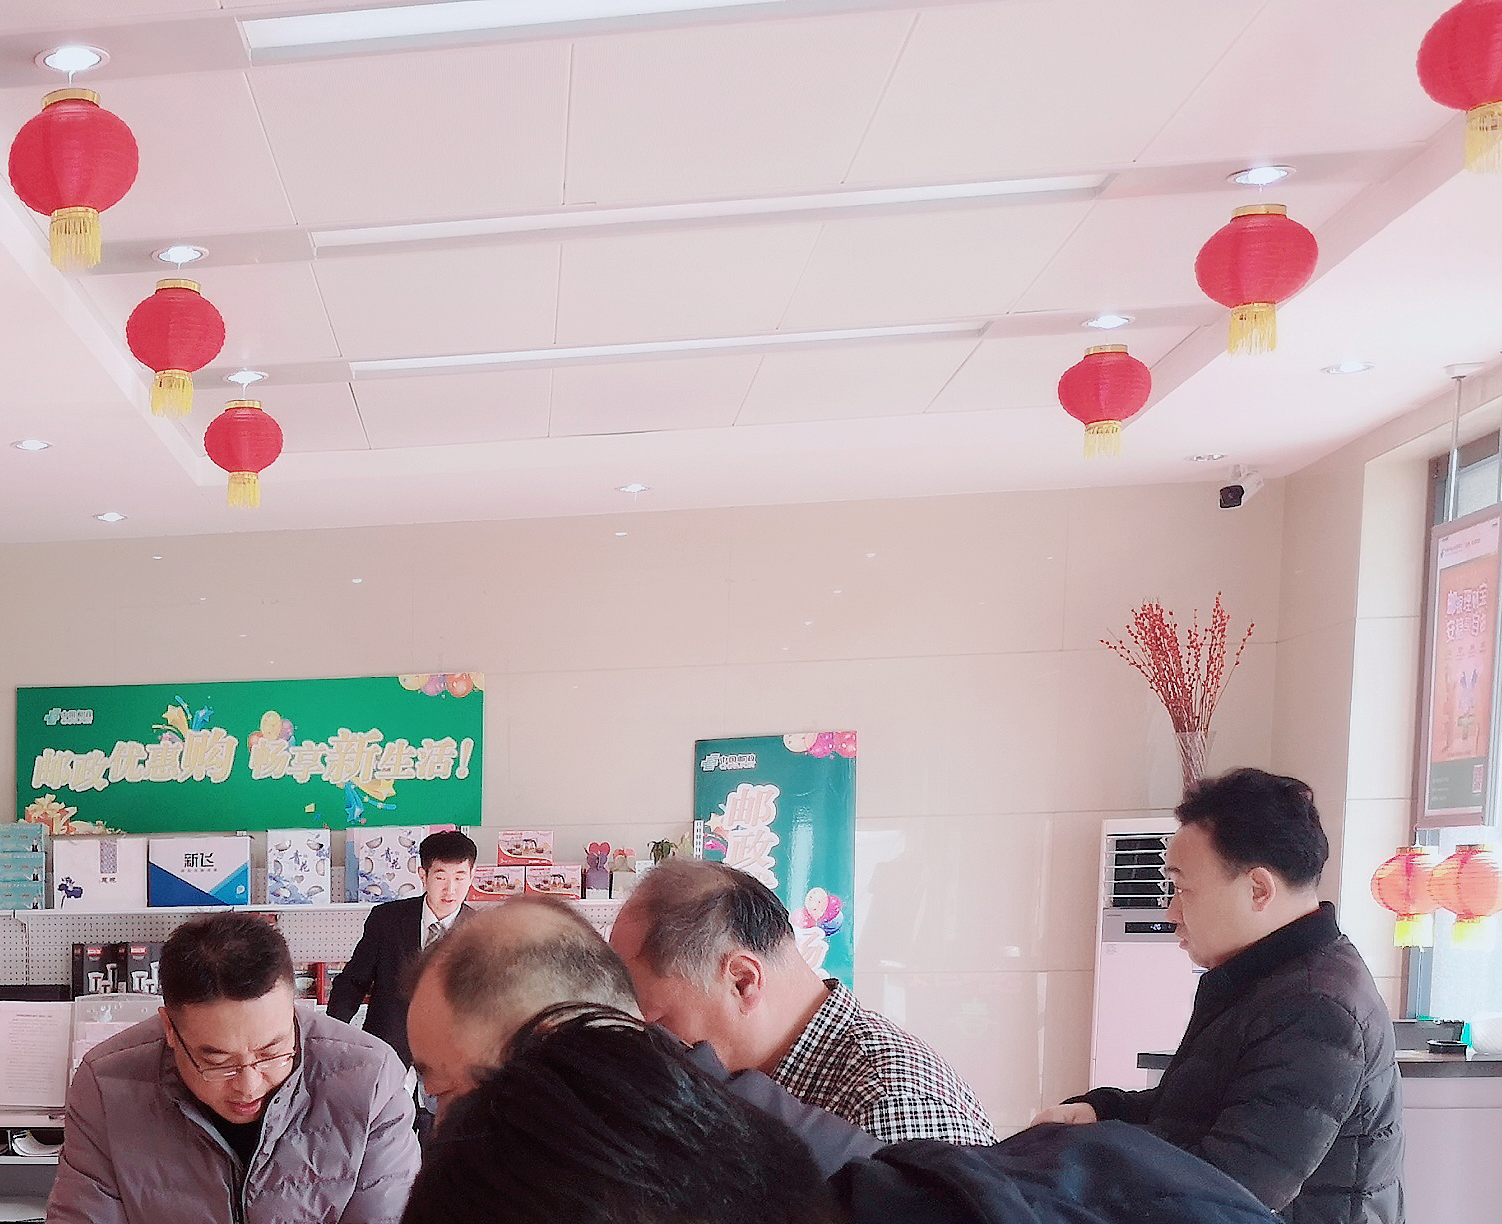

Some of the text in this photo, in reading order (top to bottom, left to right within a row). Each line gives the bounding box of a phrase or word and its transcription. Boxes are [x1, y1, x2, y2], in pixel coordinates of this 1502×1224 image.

[33, 728, 237, 791] 邮政优惠购
[184, 852, 214, 868] 新飞
[726, 783, 780, 888] 邮政
